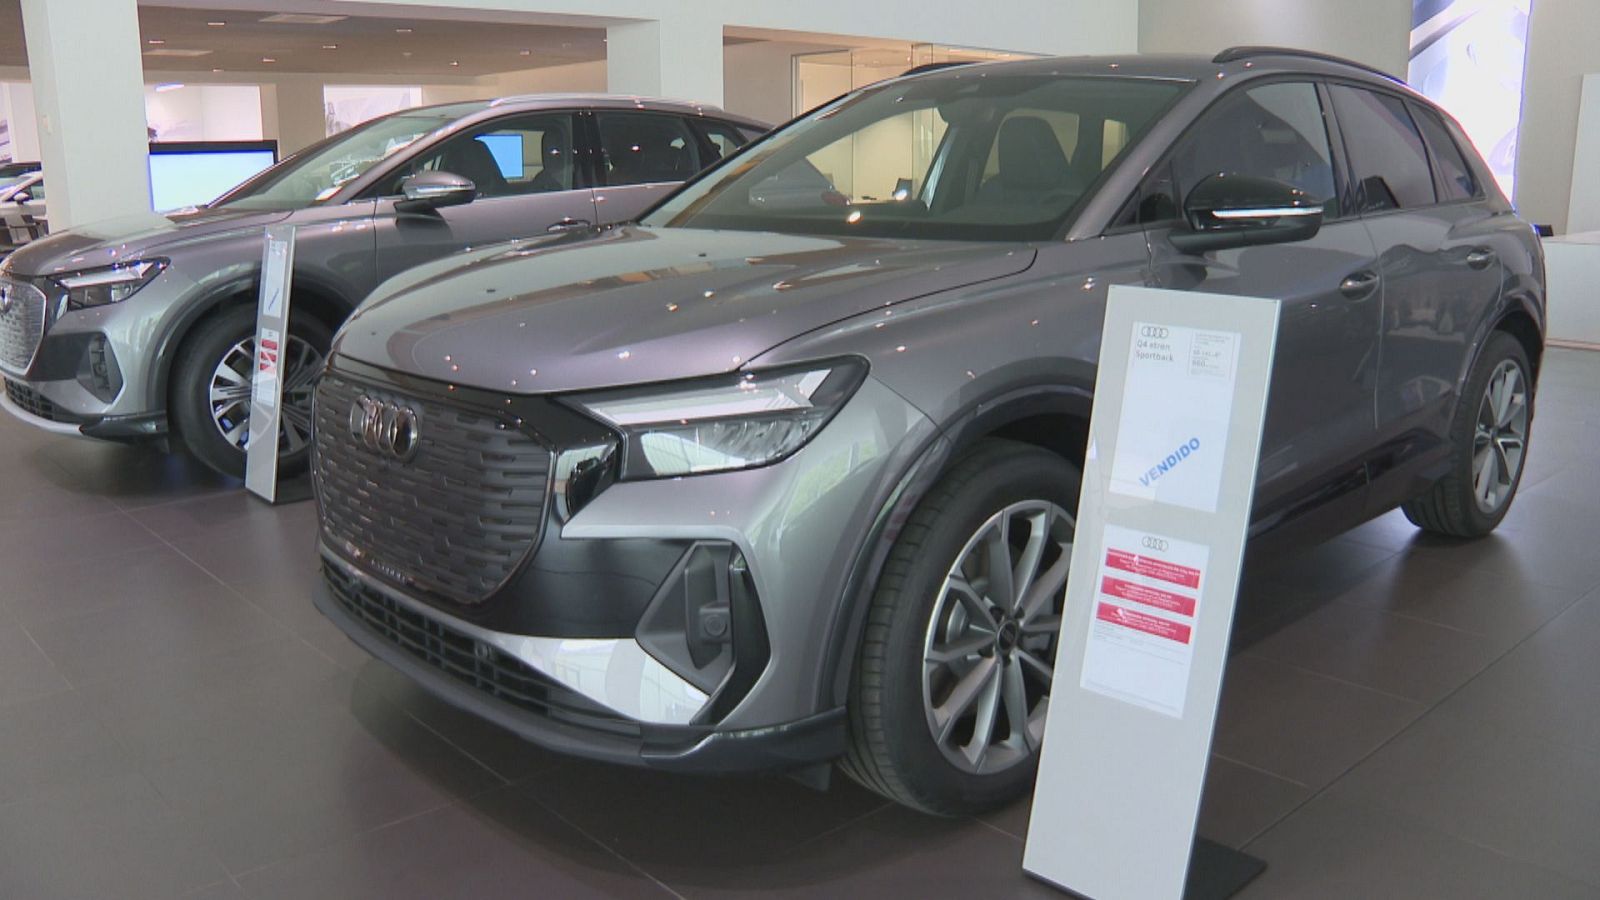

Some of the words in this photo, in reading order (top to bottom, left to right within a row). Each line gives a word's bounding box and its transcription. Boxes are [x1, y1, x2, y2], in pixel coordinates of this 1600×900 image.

[1136, 338, 1148, 349] Q4
[1135, 349, 1174, 363] Sportback
[1139, 437, 1201, 488] VENDIDO
